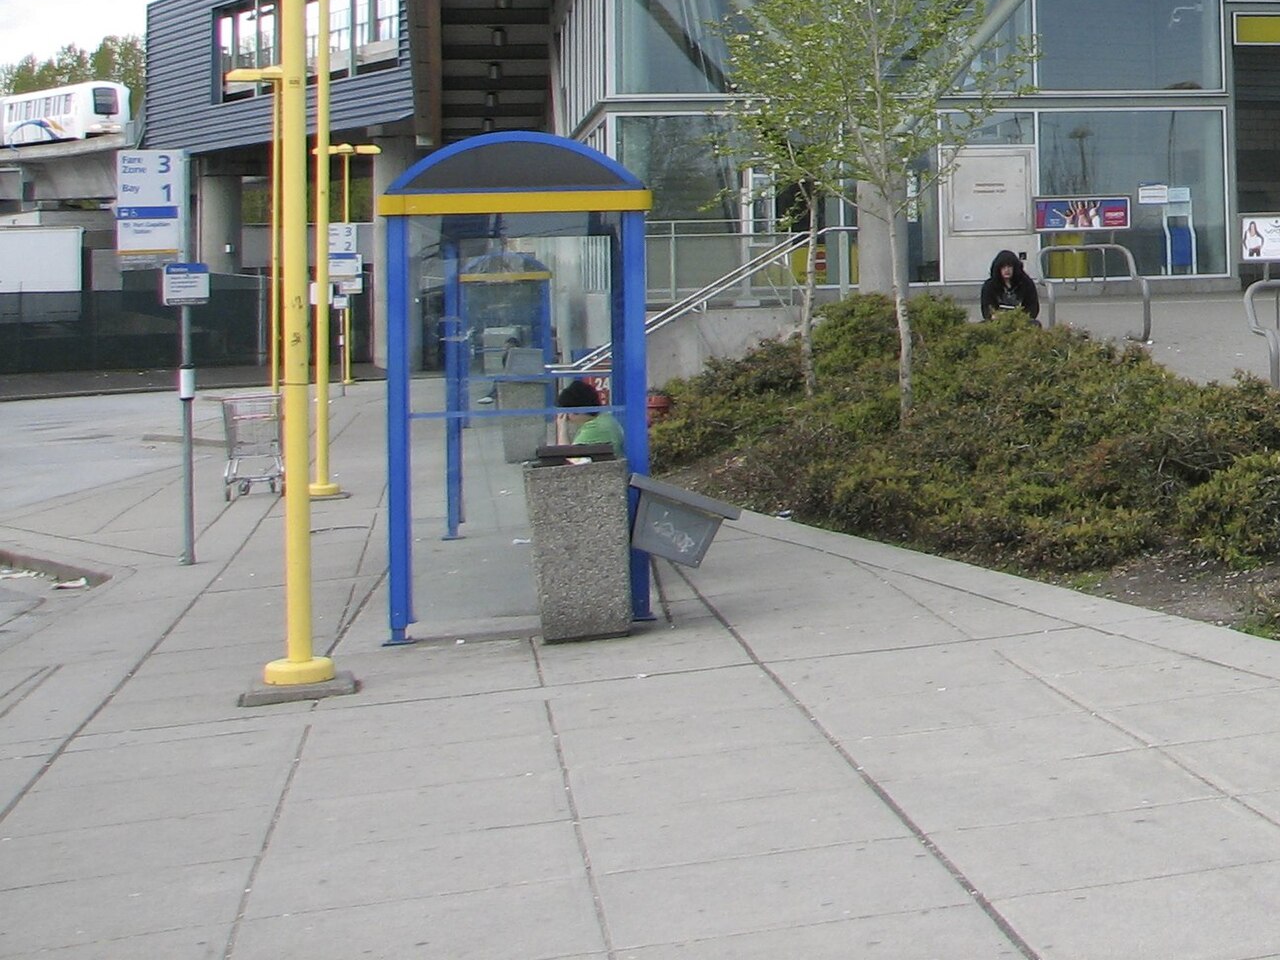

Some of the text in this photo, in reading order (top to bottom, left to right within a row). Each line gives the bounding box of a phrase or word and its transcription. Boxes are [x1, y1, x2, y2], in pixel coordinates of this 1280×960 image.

[122, 165, 147, 174] Zone
[158, 154, 171, 174] 3
[122, 184, 140, 194] Bay
[161, 183, 171, 203] 1
[345, 226, 353, 237] 3
[344, 241, 352, 252] 2
